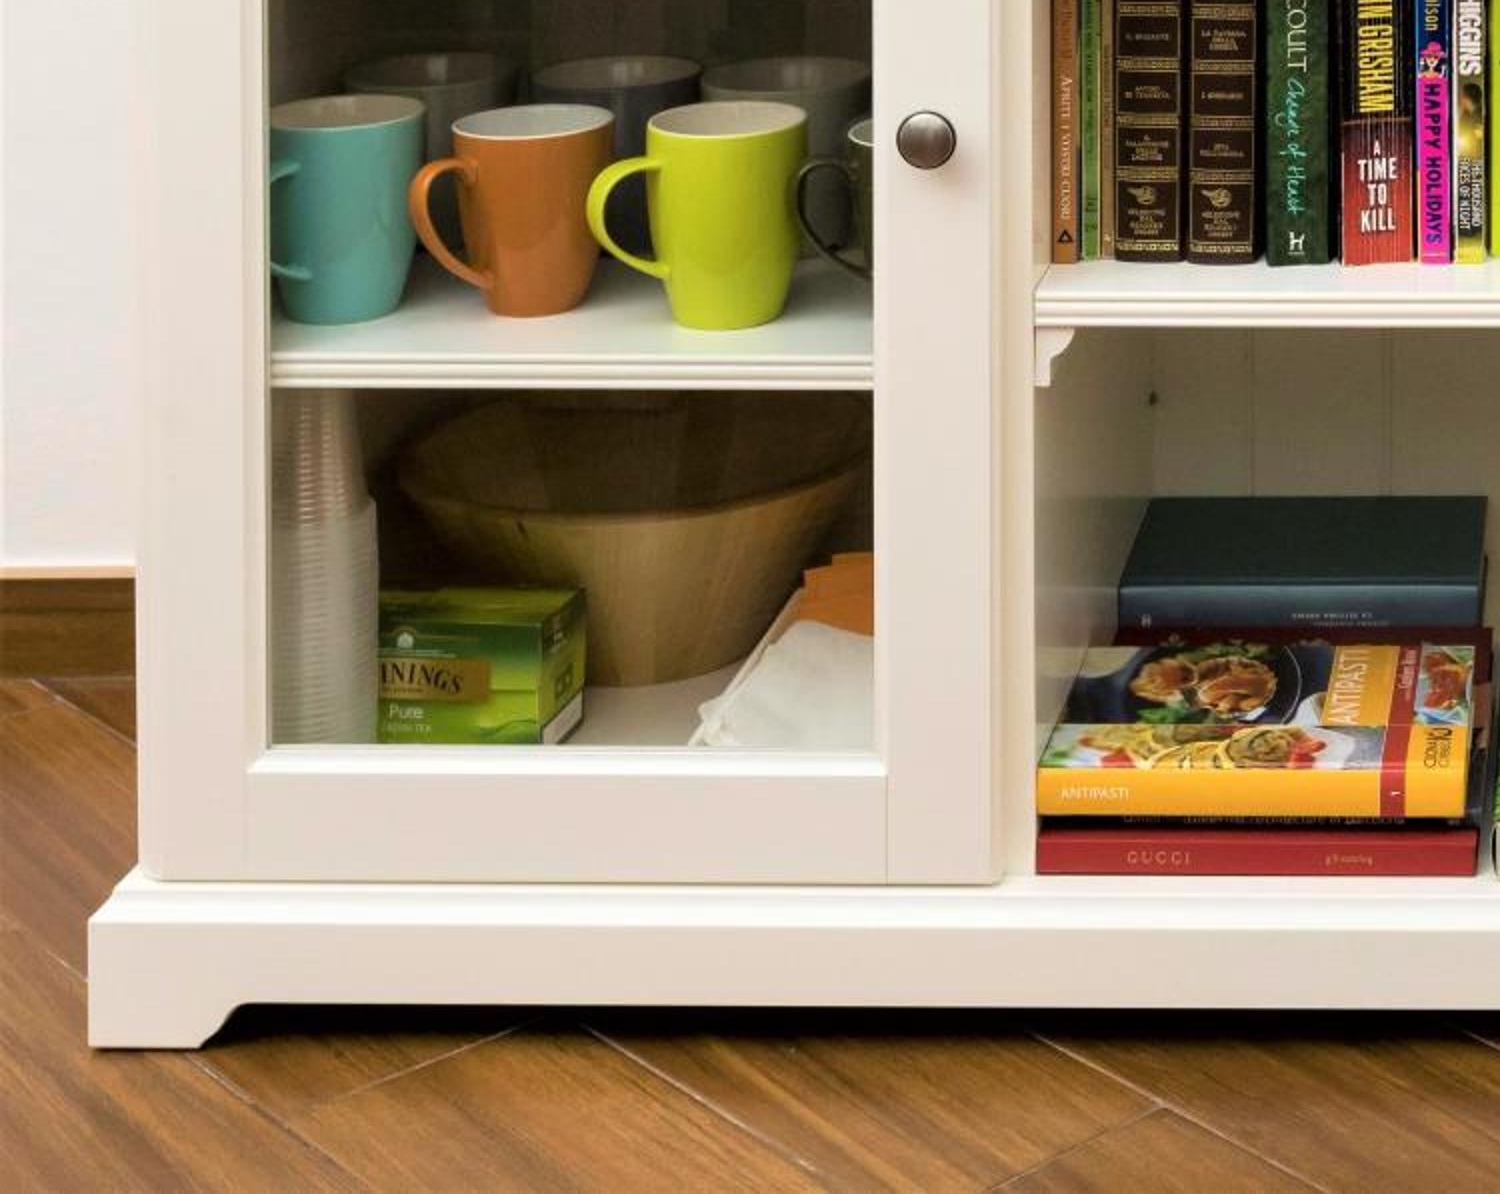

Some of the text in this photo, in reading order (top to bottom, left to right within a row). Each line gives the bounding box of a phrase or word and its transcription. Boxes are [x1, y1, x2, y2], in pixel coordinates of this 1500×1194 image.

[1359, 25, 1394, 113] GRISHAM
[1373, 140, 1381, 156] A
[1357, 157, 1398, 181] TIME
[1425, 84, 1443, 243] HAPPY HOLIDAYS
[1368, 183, 1387, 206] TO
[1361, 207, 1397, 233] KILL
[1328, 648, 1370, 725] ANTIPASTI
[389, 705, 424, 720] Pure
[1060, 787, 1130, 800] ANTIPASTI
[1126, 852, 1190, 866] GUCCI
